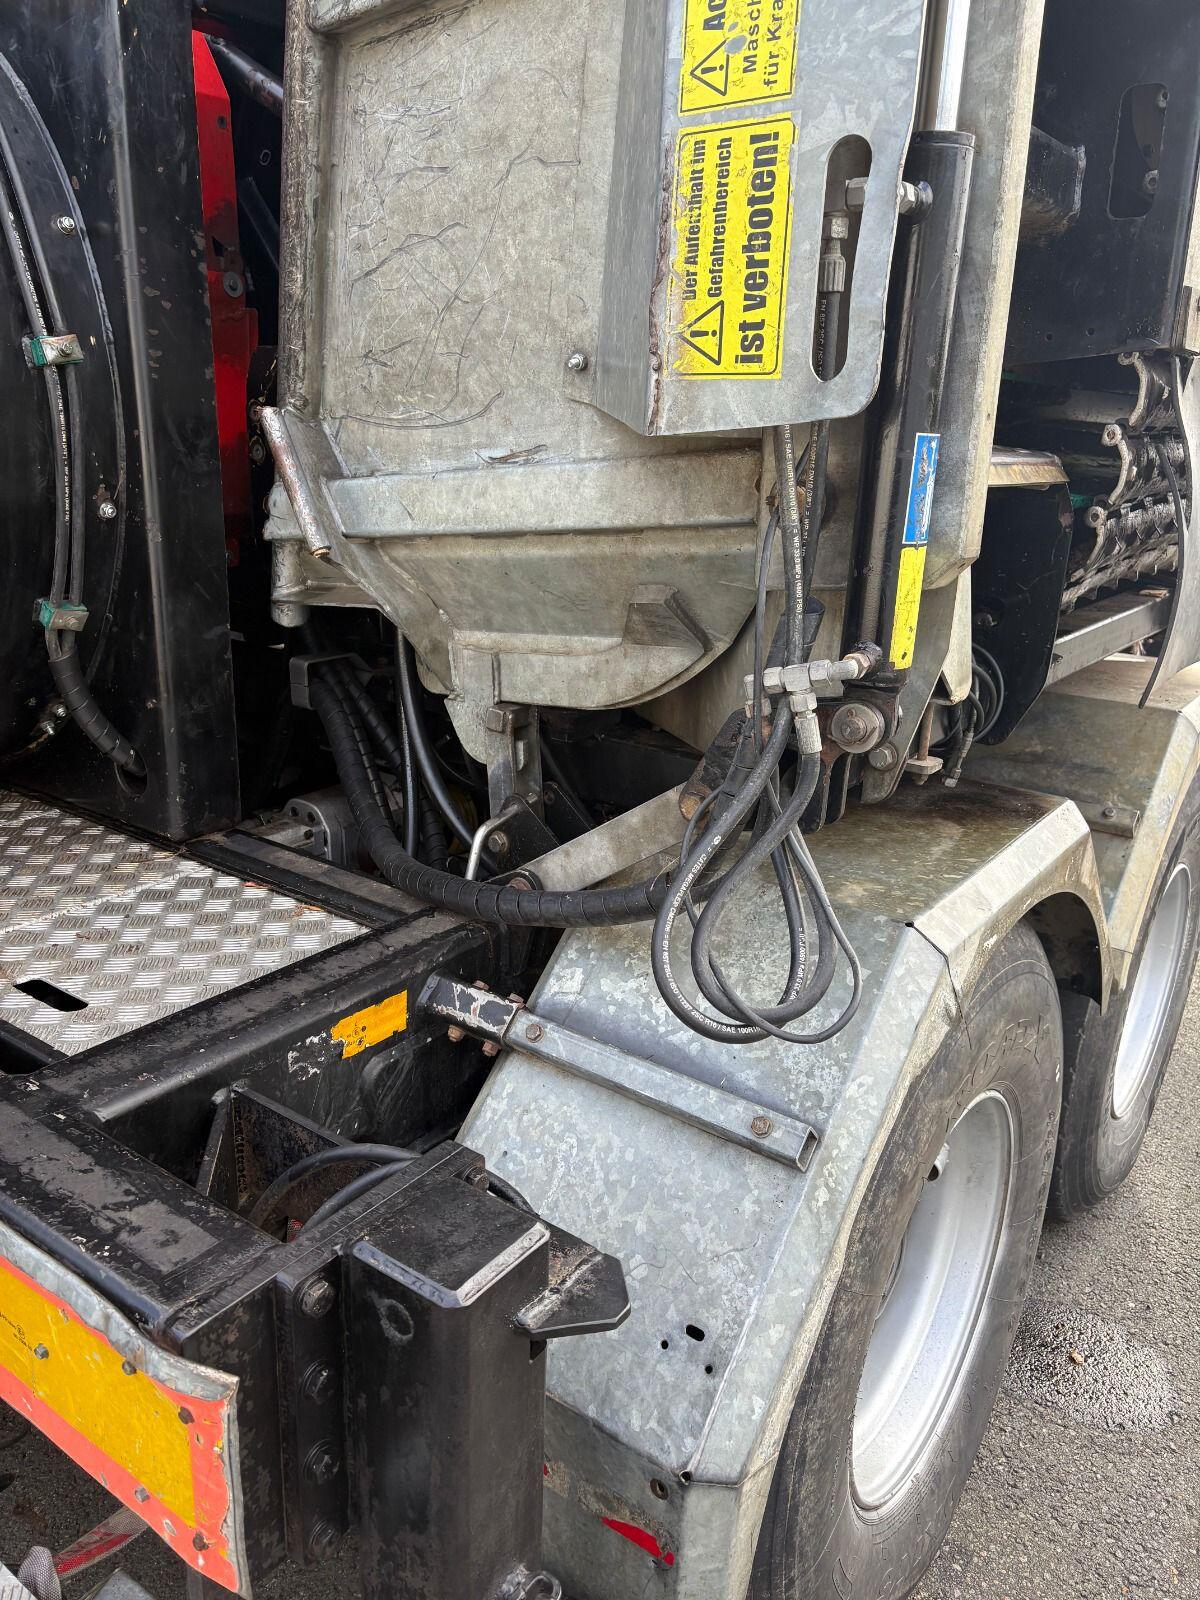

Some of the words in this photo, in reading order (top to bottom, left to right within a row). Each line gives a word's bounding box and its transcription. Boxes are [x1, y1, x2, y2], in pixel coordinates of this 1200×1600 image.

[766, 0, 785, 42] Kra
[763, 50, 780, 87] für
[682, 271, 698, 301] Der
[690, 138, 707, 164] im
[706, 136, 733, 299] Gefahrenbereich
[741, 131, 780, 313] verboten!
[735, 318, 766, 365] ist
[785, 443, 793, 460] SAE
[792, 535, 801, 550] WP
[794, 564, 803, 579] MPa
[721, 1024, 737, 1034] SAE
